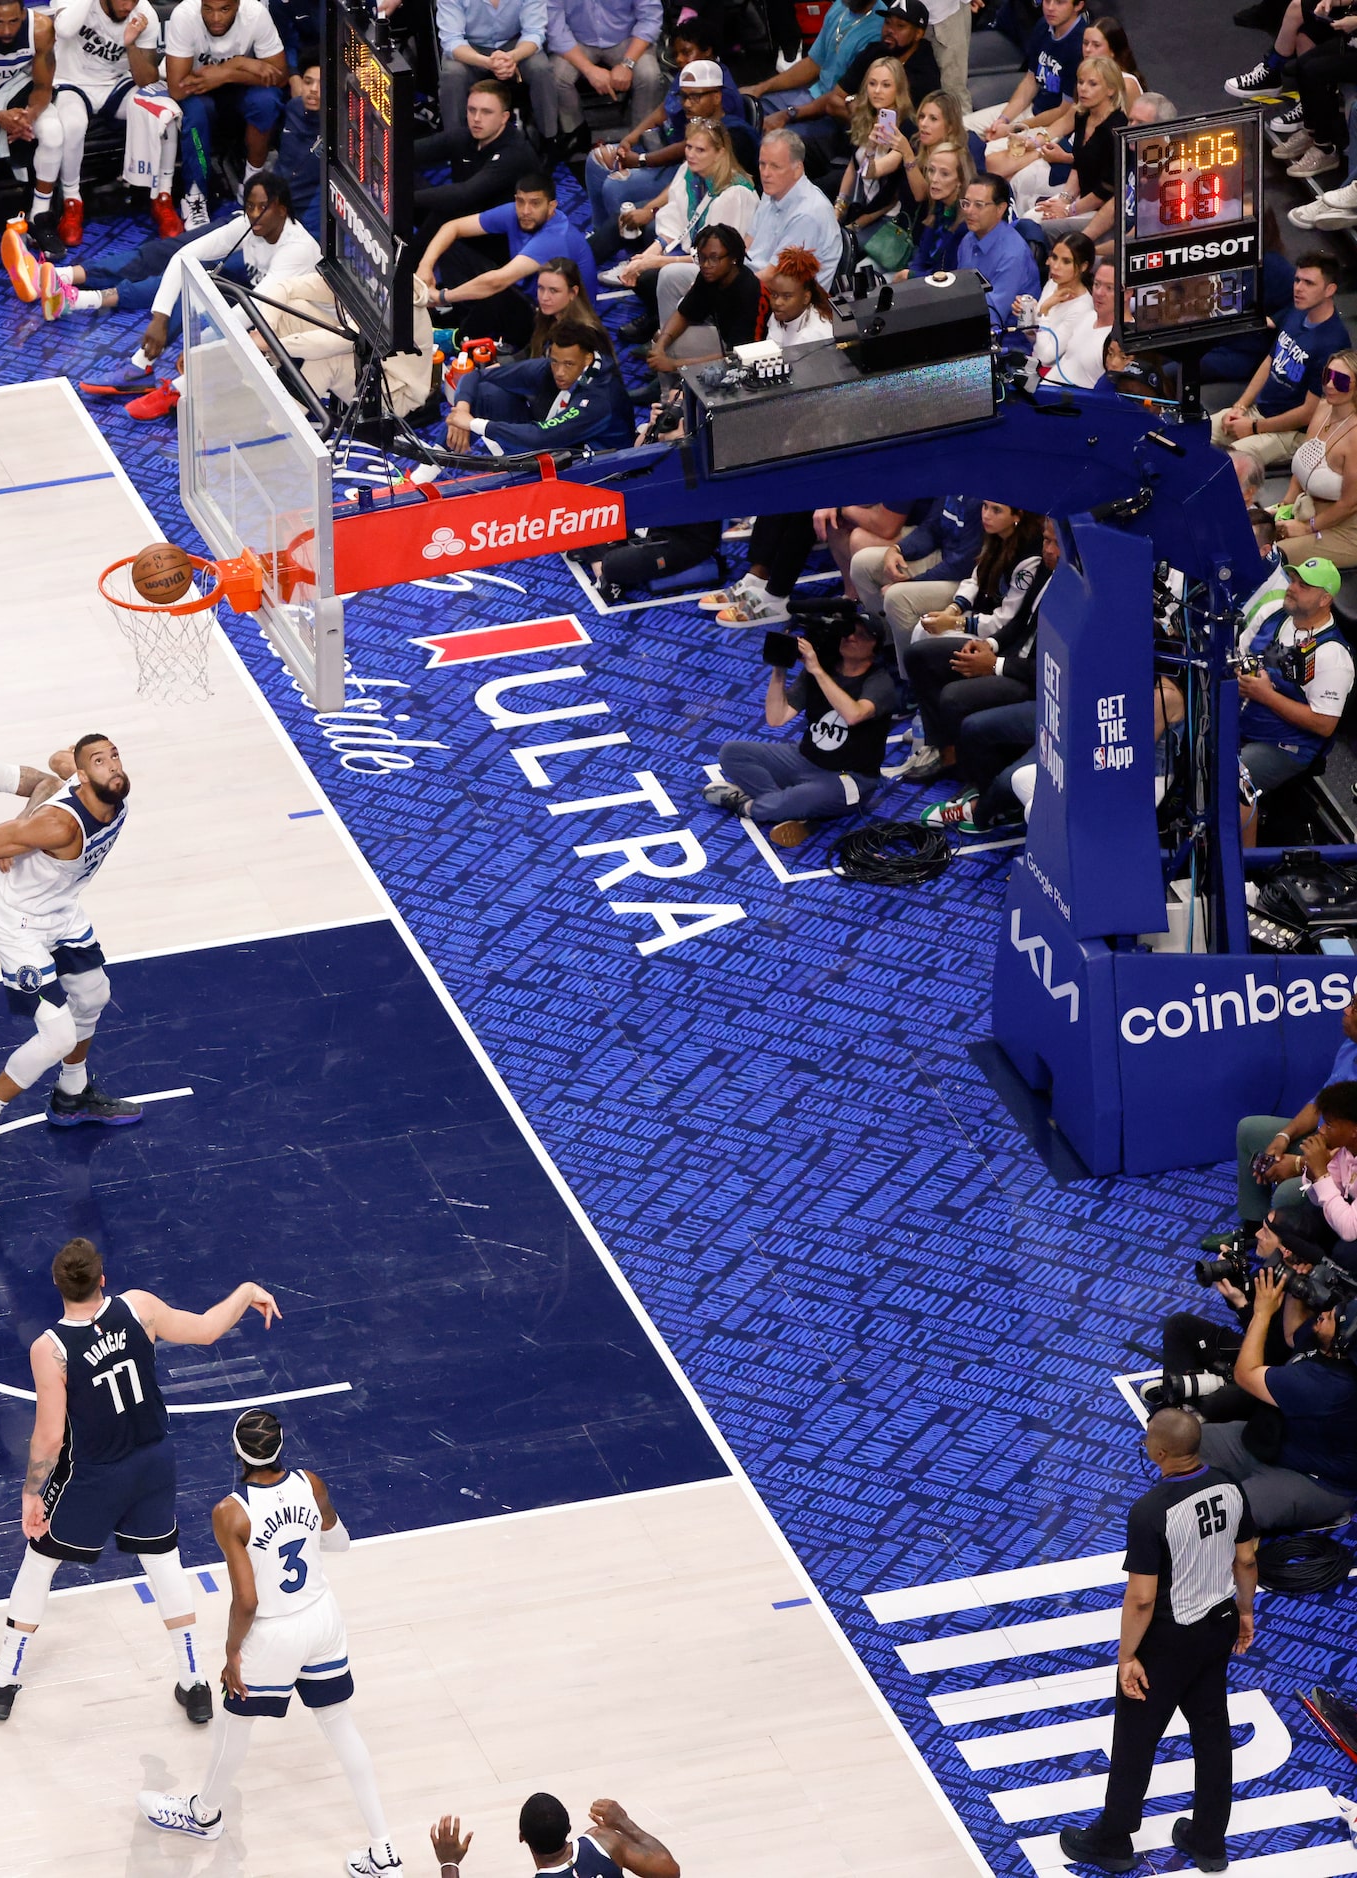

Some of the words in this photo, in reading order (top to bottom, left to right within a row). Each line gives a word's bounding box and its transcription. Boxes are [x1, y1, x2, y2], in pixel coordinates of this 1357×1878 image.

[344, 205, 389, 274] TISSOT
[1165, 236, 1255, 265] TISSOT
[351, 648, 419, 674] VINCENT
[1044, 652, 1061, 701] GET
[1044, 690, 1061, 742] THE
[1097, 694, 1126, 721] GET
[1098, 718, 1127, 744] THE
[1047, 734, 1064, 793] App
[1107, 746, 1134, 771] App
[358, 806, 389, 821] STEVE
[391, 814, 434, 832] ALFORD
[475, 665, 747, 957] ULTRA
[387, 873, 417, 888] RAJA
[415, 880, 445, 896] BELL
[789, 881, 875, 910] DAMPIER
[1027, 852, 1053, 898] Google
[1054, 888, 1070, 921] Pixel
[406, 910, 447, 926] DENNIS
[448, 921, 489, 937] SMITH
[789, 897, 834, 915] SAMAKI
[832, 905, 880, 926] WALKER
[796, 916, 860, 946] DIRK
[852, 929, 970, 971] NOWITZKI
[879, 919, 943, 942] DESHAWN
[742, 934, 851, 971] STACKHOUSE
[523, 968, 562, 988] JAY
[559, 975, 633, 1002] VINCENT
[552, 948, 642, 983] MICHAEL
[638, 968, 715, 996] FINLEY
[692, 967, 728, 981] JUSTIN
[725, 974, 772, 992] JACKSON
[846, 962, 908, 989] MARK
[902, 975, 986, 1008] AGUIRRE
[472, 1000, 522, 1020] ERICK
[517, 1011, 604, 1041] STRICKLAND
[485, 983, 549, 1009] RANDY
[545, 999, 603, 1023] WHITE
[671, 995, 701, 1010] OLLIE
[699, 1003, 732, 1017] MACK
[758, 990, 807, 1014] JOSH
[804, 1001, 890, 1033] HOWARD
[484, 1018, 543, 1041] MARQUIS
[538, 1032, 592, 1054] DANIELS
[687, 1018, 766, 1048] HARRISON
[764, 1037, 828, 1063] BARNES
[731, 1009, 794, 1037] DORIAN
[795, 1024, 913, 1065] FINNEY-SMITH
[498, 1055, 533, 1071] LOREN
[533, 1063, 573, 1080] MEYER
[793, 1095, 839, 1115] SEAN
[835, 1104, 886, 1127] ROOKS
[1026, 1187, 1104, 1220] DEREK
[1096, 1204, 1190, 1241] HARPER
[1107, 1181, 1225, 1223] WENNINGTON
[771, 1220, 808, 1237] RAEF
[803, 1228, 868, 1251] LAFRENTZ
[837, 1216, 889, 1236] ROBERT
[887, 1227, 924, 1245] PACK
[1017, 1220, 1108, 1256] DAMPIER
[1081, 1222, 1121, 1239] LORENZO
[1121, 1233, 1168, 1251] WILLIAMS
[761, 1234, 816, 1261] LUKA
[810, 1248, 891, 1278] DONČIĆ
[1016, 1241, 1064, 1262] SAMAKI
[1062, 1252, 1111, 1273] WALKER
[886, 1286, 954, 1316] BRAD
[1025, 1263, 1091, 1294] DIRK
[1082, 1277, 1206, 1317] NOWITZKI
[772, 1296, 865, 1334] MICHAEL
[861, 1317, 941, 1350] FINLEY
[83, 1328, 127, 1367] DONČIĆ
[702, 1334, 768, 1363] RANDY
[763, 1350, 825, 1378] WHITE
[986, 1342, 1037, 1369] JOSH
[1035, 1353, 1124, 1388] HOWARD
[92, 1358, 144, 1415] 77
[688, 1351, 738, 1373] ERICK
[732, 1363, 827, 1396] STRICKLAND
[766, 1461, 861, 1498] DESAGANA
[856, 1484, 906, 1507] DIOP
[820, 1460, 868, 1478] HOWARD
[863, 1470, 904, 1488] EISLEY
[1031, 1459, 1075, 1481] SEAN
[1074, 1469, 1127, 1494] ROOKS
[779, 1488, 814, 1507] JAE
[809, 1494, 888, 1525] CROWDER
[908, 1479, 956, 1500] GEORGE
[951, 1490, 1011, 1514] MCCLOUD
[941, 1504, 983, 1523] WOOD
[252, 1505, 319, 1551] McDANIELS
[795, 1510, 834, 1527] STEVE
[829, 1520, 876, 1539] ALFORD
[1195, 1494, 1227, 1539] 25
[278, 1537, 308, 1594] 3
[1265, 1595, 1357, 1633] DAMPIER
[1266, 1618, 1317, 1638] SAMAKI
[1275, 1642, 1345, 1675] DIRK
